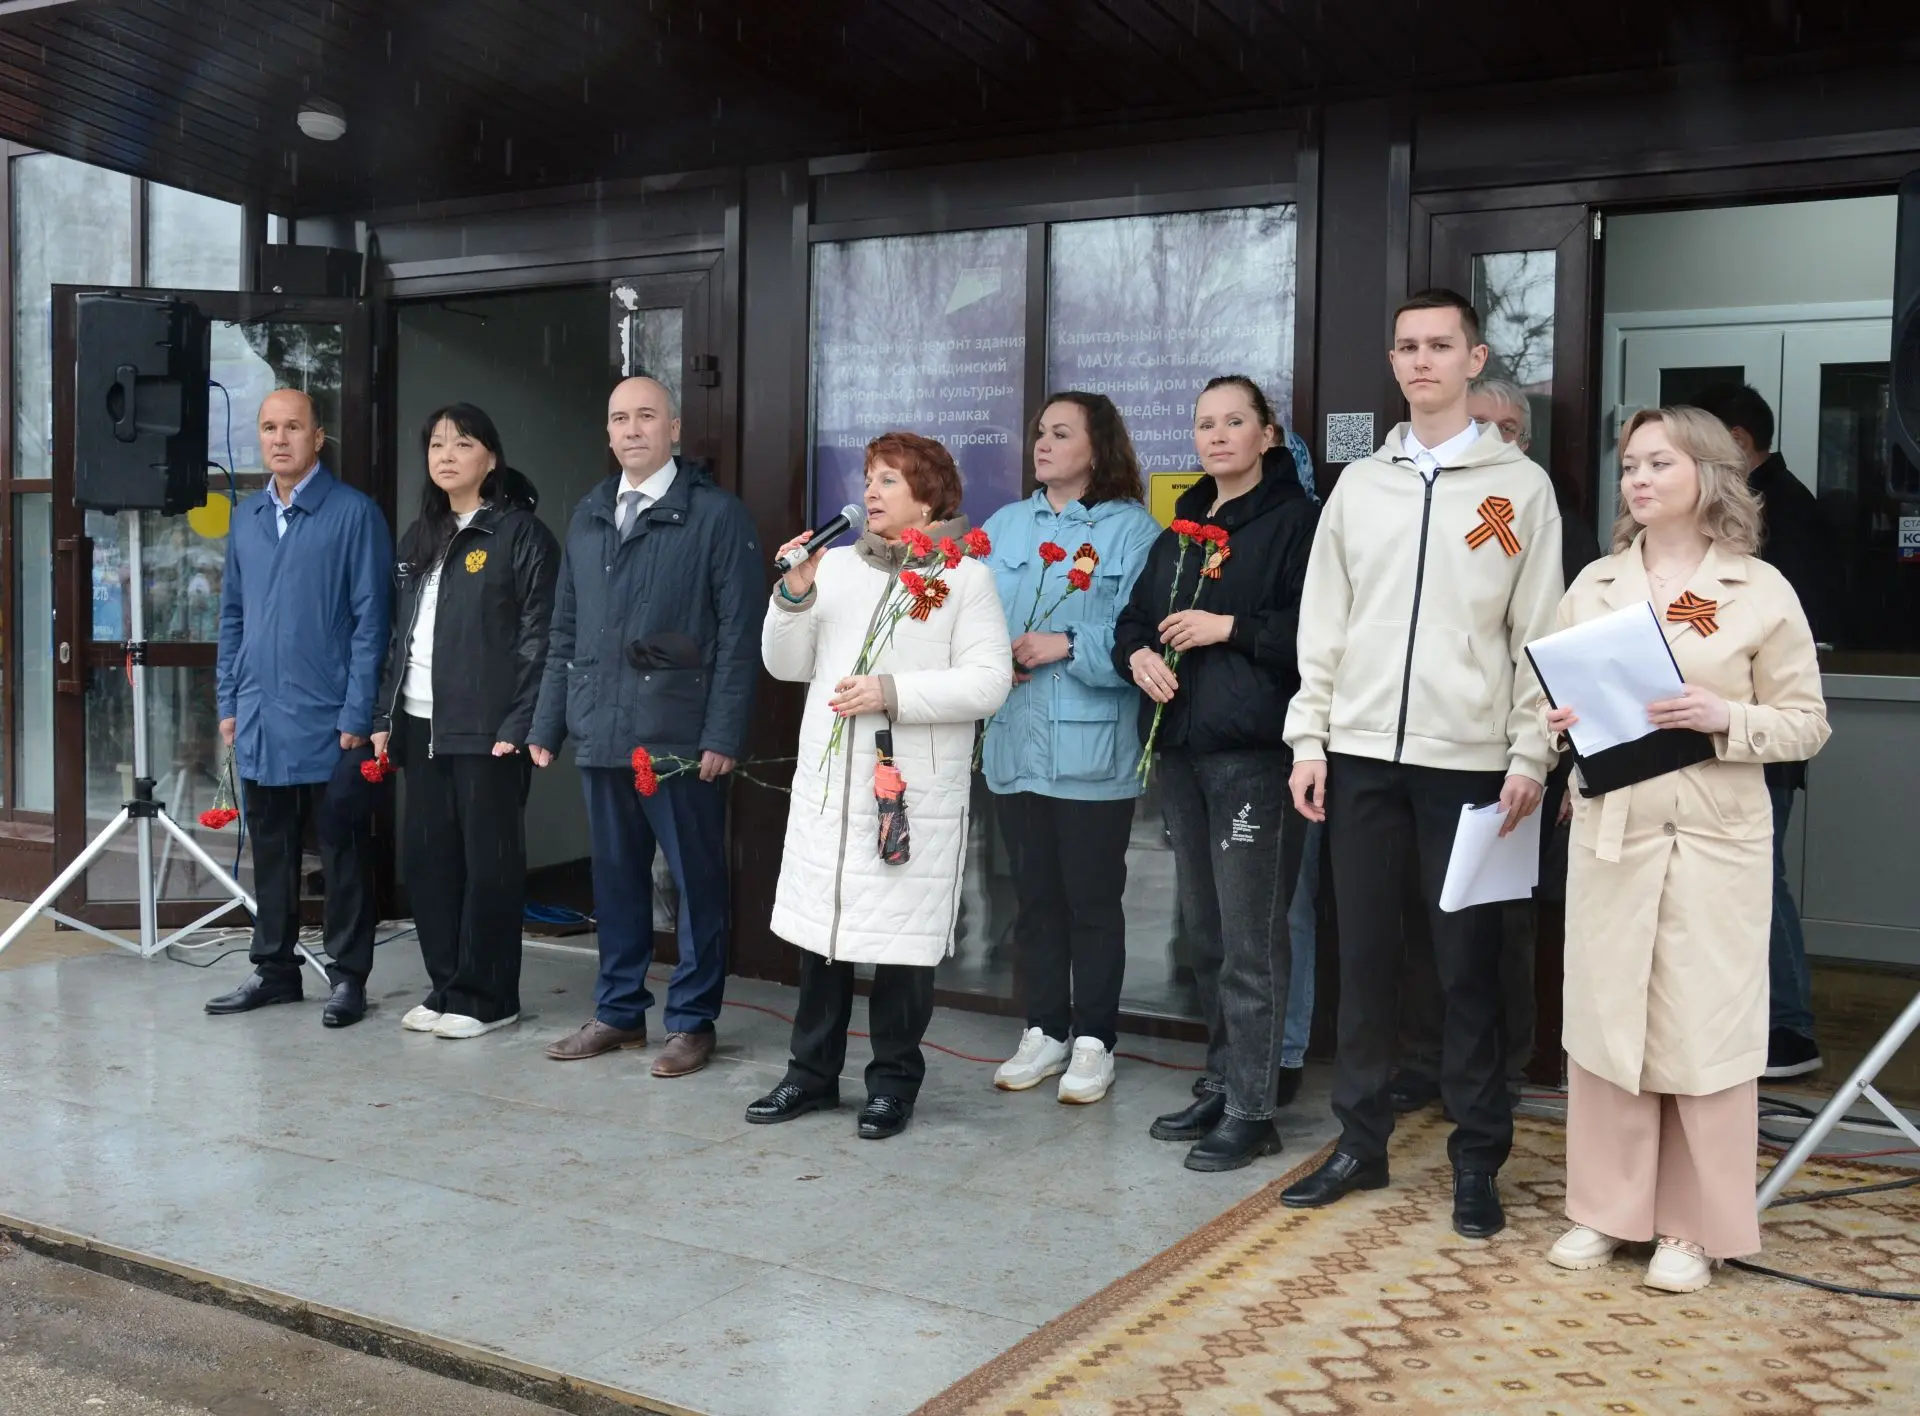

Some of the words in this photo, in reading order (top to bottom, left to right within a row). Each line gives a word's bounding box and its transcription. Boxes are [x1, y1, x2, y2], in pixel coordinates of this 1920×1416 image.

[975, 335, 1026, 352] здания
[1058, 325, 1162, 346] Капитальный
[1077, 351, 1123, 369] МАУК
[908, 387, 935, 401] дом
[940, 385, 1014, 401] культуры»
[1154, 378, 1186, 393] дом
[926, 411, 935, 422] в
[938, 409, 990, 425] рамках
[1176, 403, 1185, 415] в
[950, 432, 1008, 449] проекта
